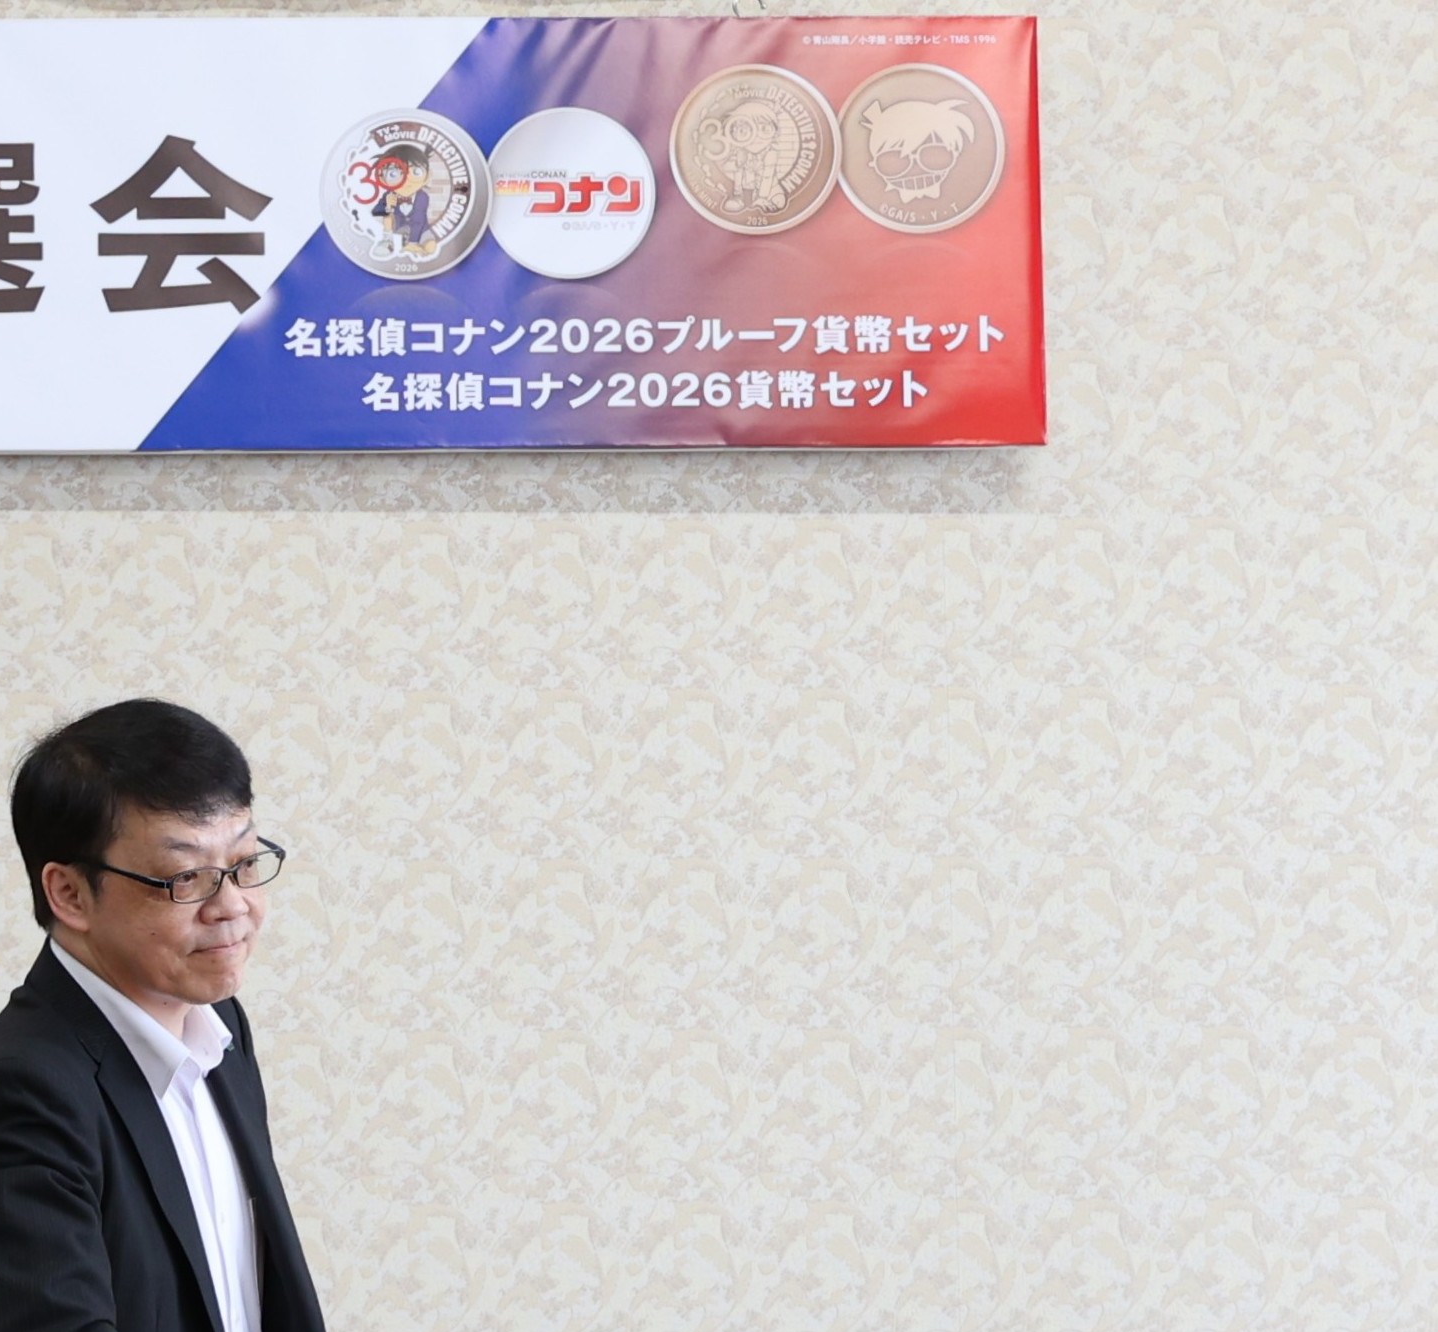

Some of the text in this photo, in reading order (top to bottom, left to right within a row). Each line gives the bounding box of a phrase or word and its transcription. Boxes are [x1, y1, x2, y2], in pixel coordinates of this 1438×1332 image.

[384, 130, 417, 143] MOVIE
[417, 126, 468, 238] DETECTIVE CONAN
[530, 170, 567, 178] CONAN
[781, 149, 815, 193] CONAN
[530, 176, 641, 213] コナン
[394, 263, 419, 272] 2026
[284, 314, 1005, 358] 名探偵コナン2026プルーフ貨幣セット
[363, 370, 929, 412] 名探偵コナン2026貨幣セット
